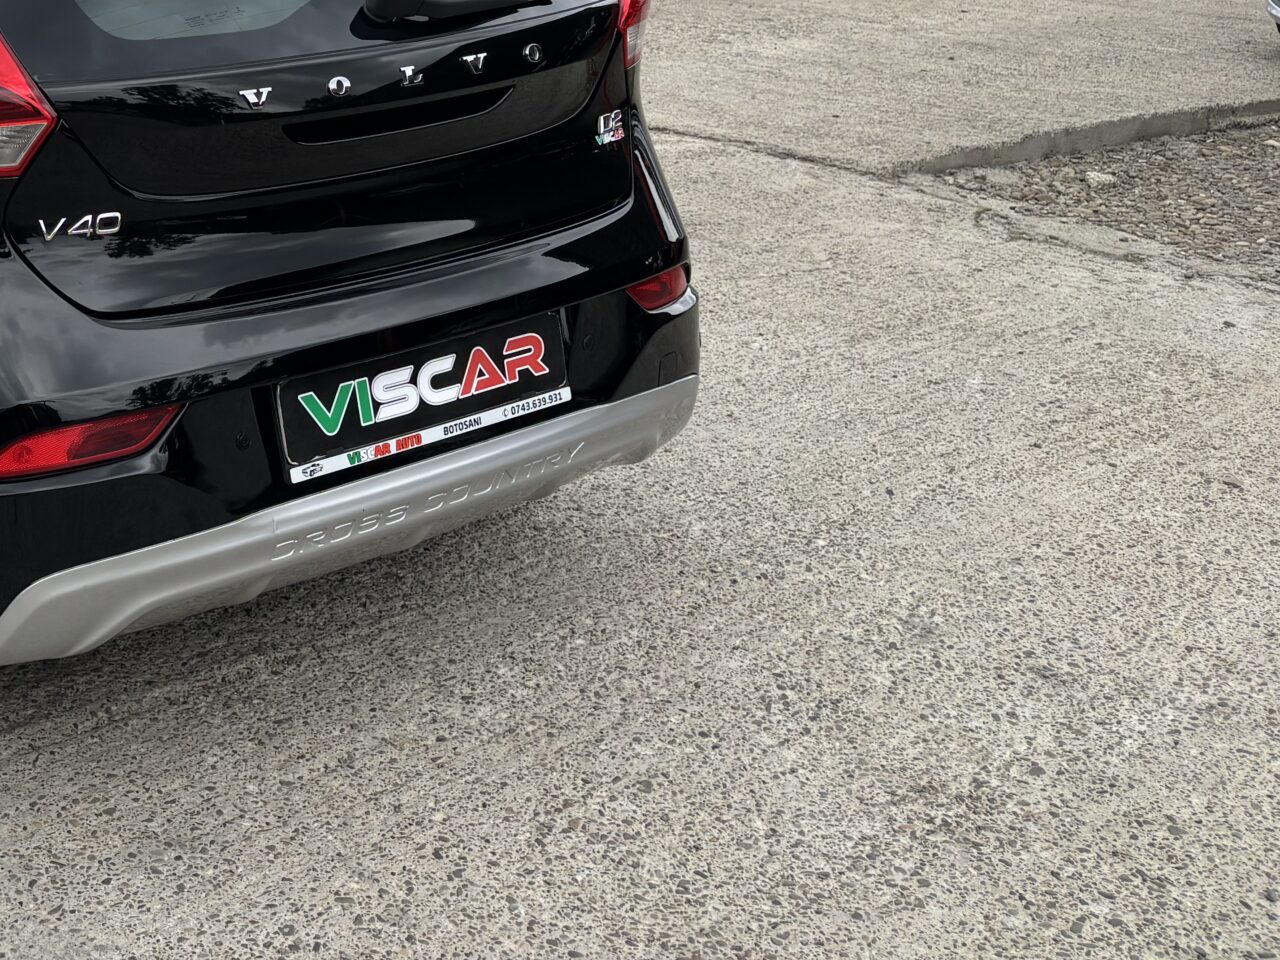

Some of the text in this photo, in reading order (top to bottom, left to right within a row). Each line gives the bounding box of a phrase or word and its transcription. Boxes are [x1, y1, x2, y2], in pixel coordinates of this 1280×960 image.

[238, 43, 543, 109] VOLVO
[597, 109, 623, 134] D2
[38, 210, 122, 241] V40
[297, 332, 550, 436] VISCAR
[347, 391, 564, 466] VISCAR AUTO BOTOSANI 0743.639.931
[271, 441, 586, 561] CROSS COUNTRY
